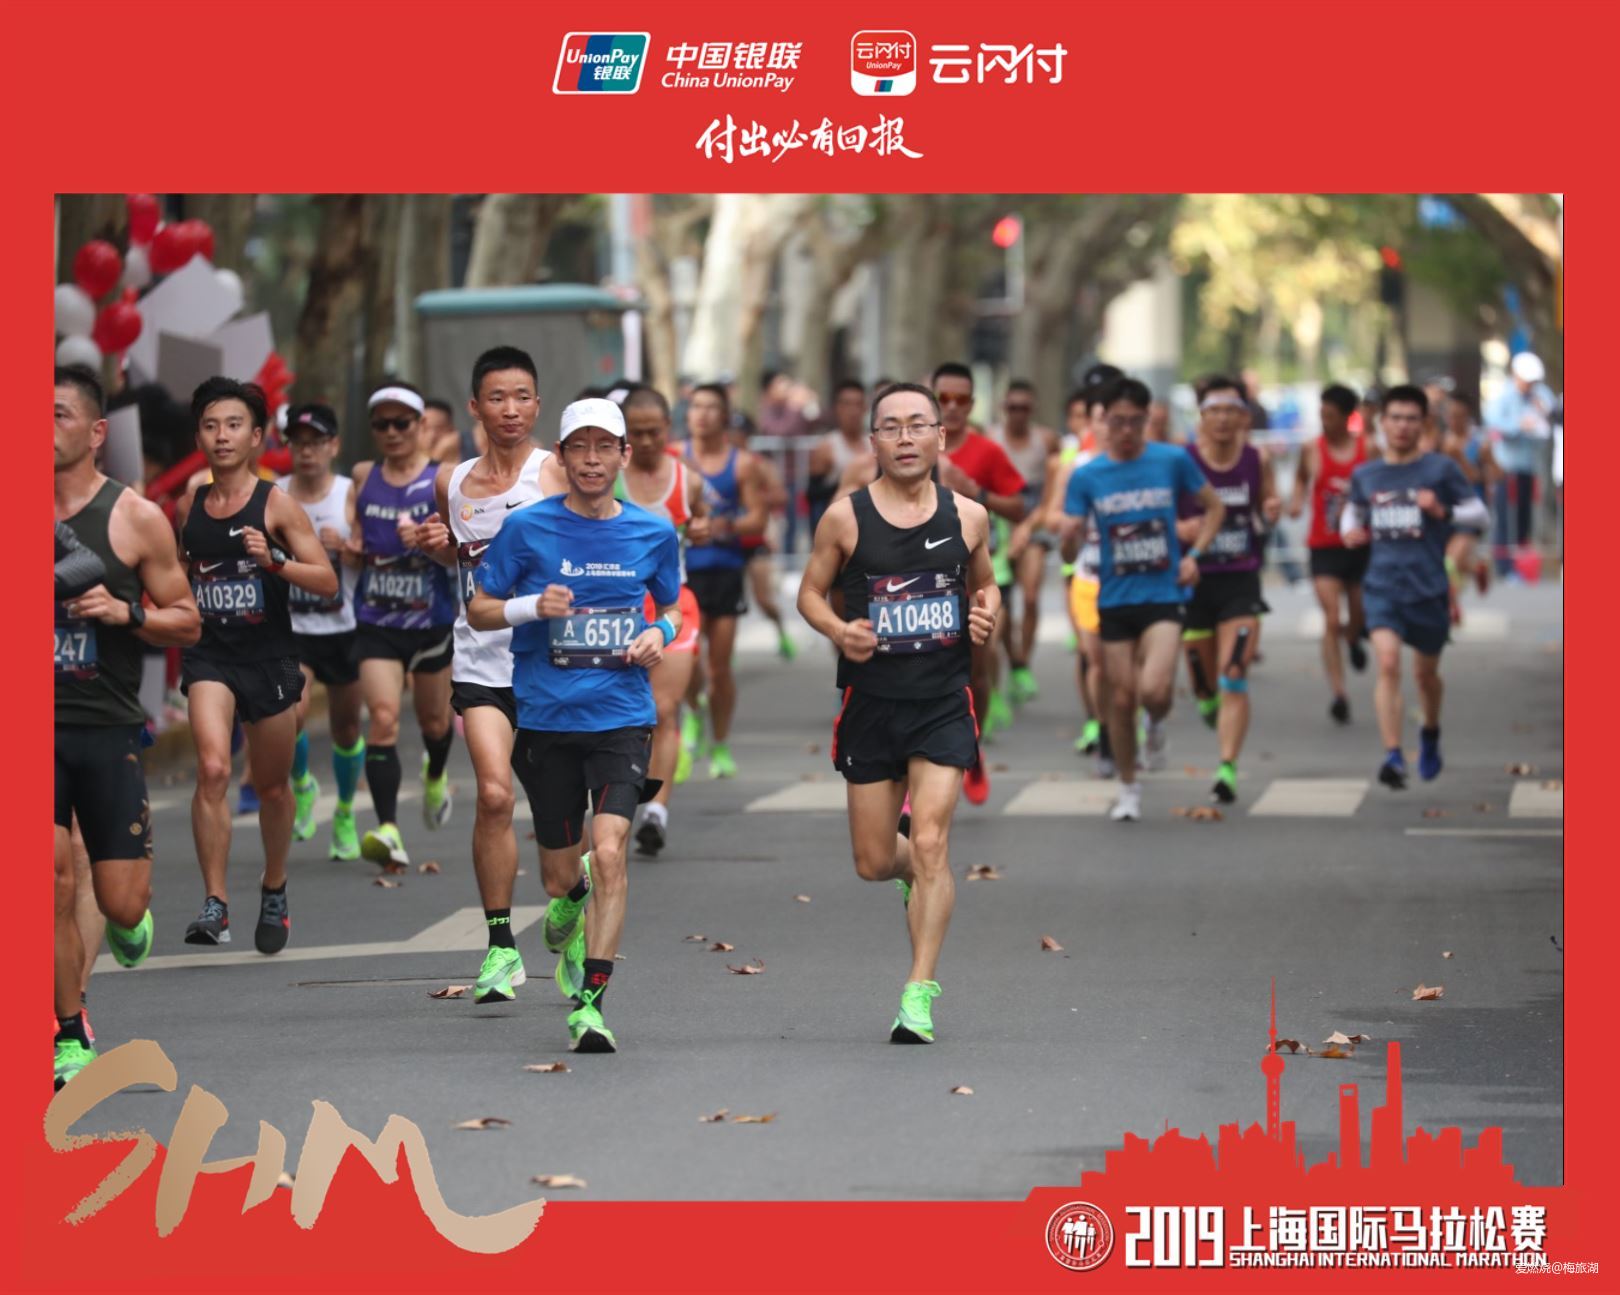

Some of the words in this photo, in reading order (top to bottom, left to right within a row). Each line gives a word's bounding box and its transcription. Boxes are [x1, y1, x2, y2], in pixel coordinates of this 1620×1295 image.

[196, 584, 257, 609] A10329
[367, 572, 422, 598] A10271
[877, 600, 954, 634] A10488
[563, 620, 575, 638] A
[584, 618, 635, 647] 6512
